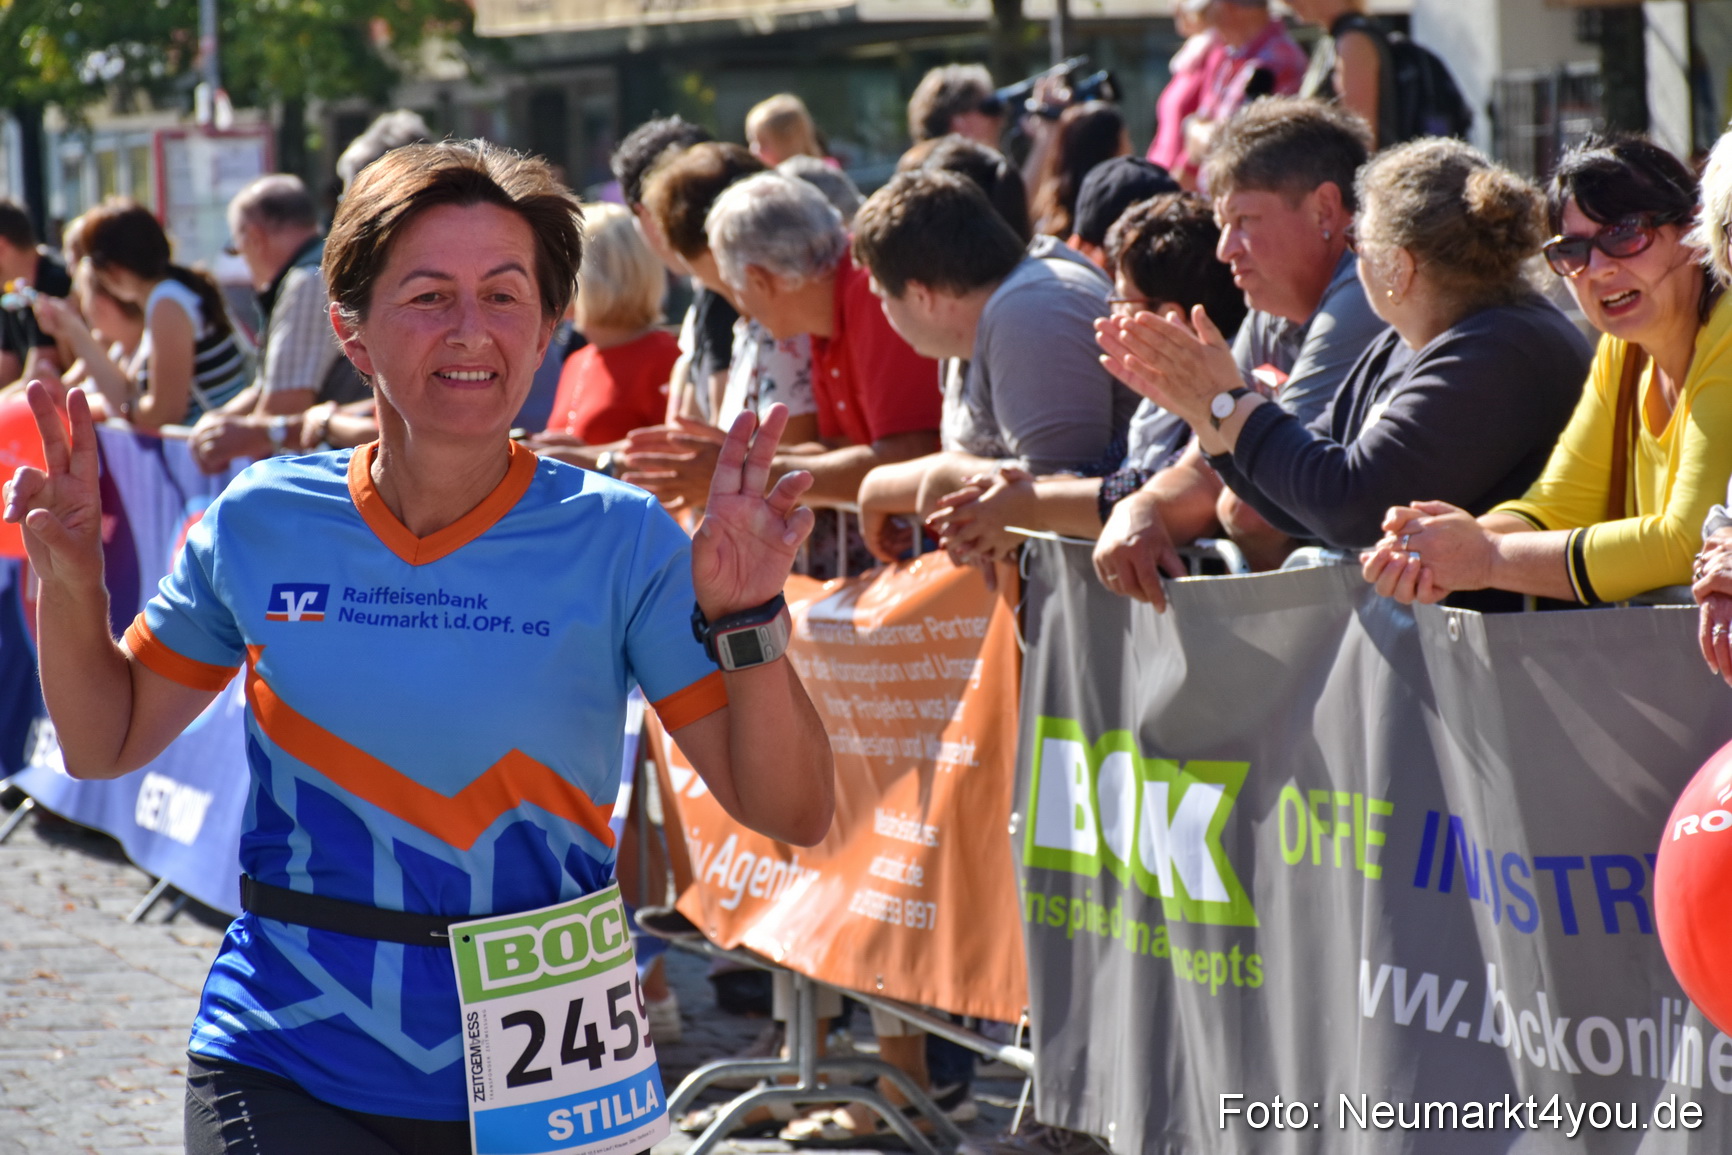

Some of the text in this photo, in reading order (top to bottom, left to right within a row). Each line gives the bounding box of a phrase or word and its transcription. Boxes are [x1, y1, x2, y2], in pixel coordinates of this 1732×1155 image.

[342, 586, 488, 611] Raiffeisenbank
[338, 607, 550, 637] Neumarkt i.d.OPf. eG
[924, 616, 988, 641] Partner
[1278, 785, 1394, 880] OFFIE
[904, 898, 937, 930] 897
[479, 901, 631, 985] BOC
[547, 1079, 660, 1141] STILLA
